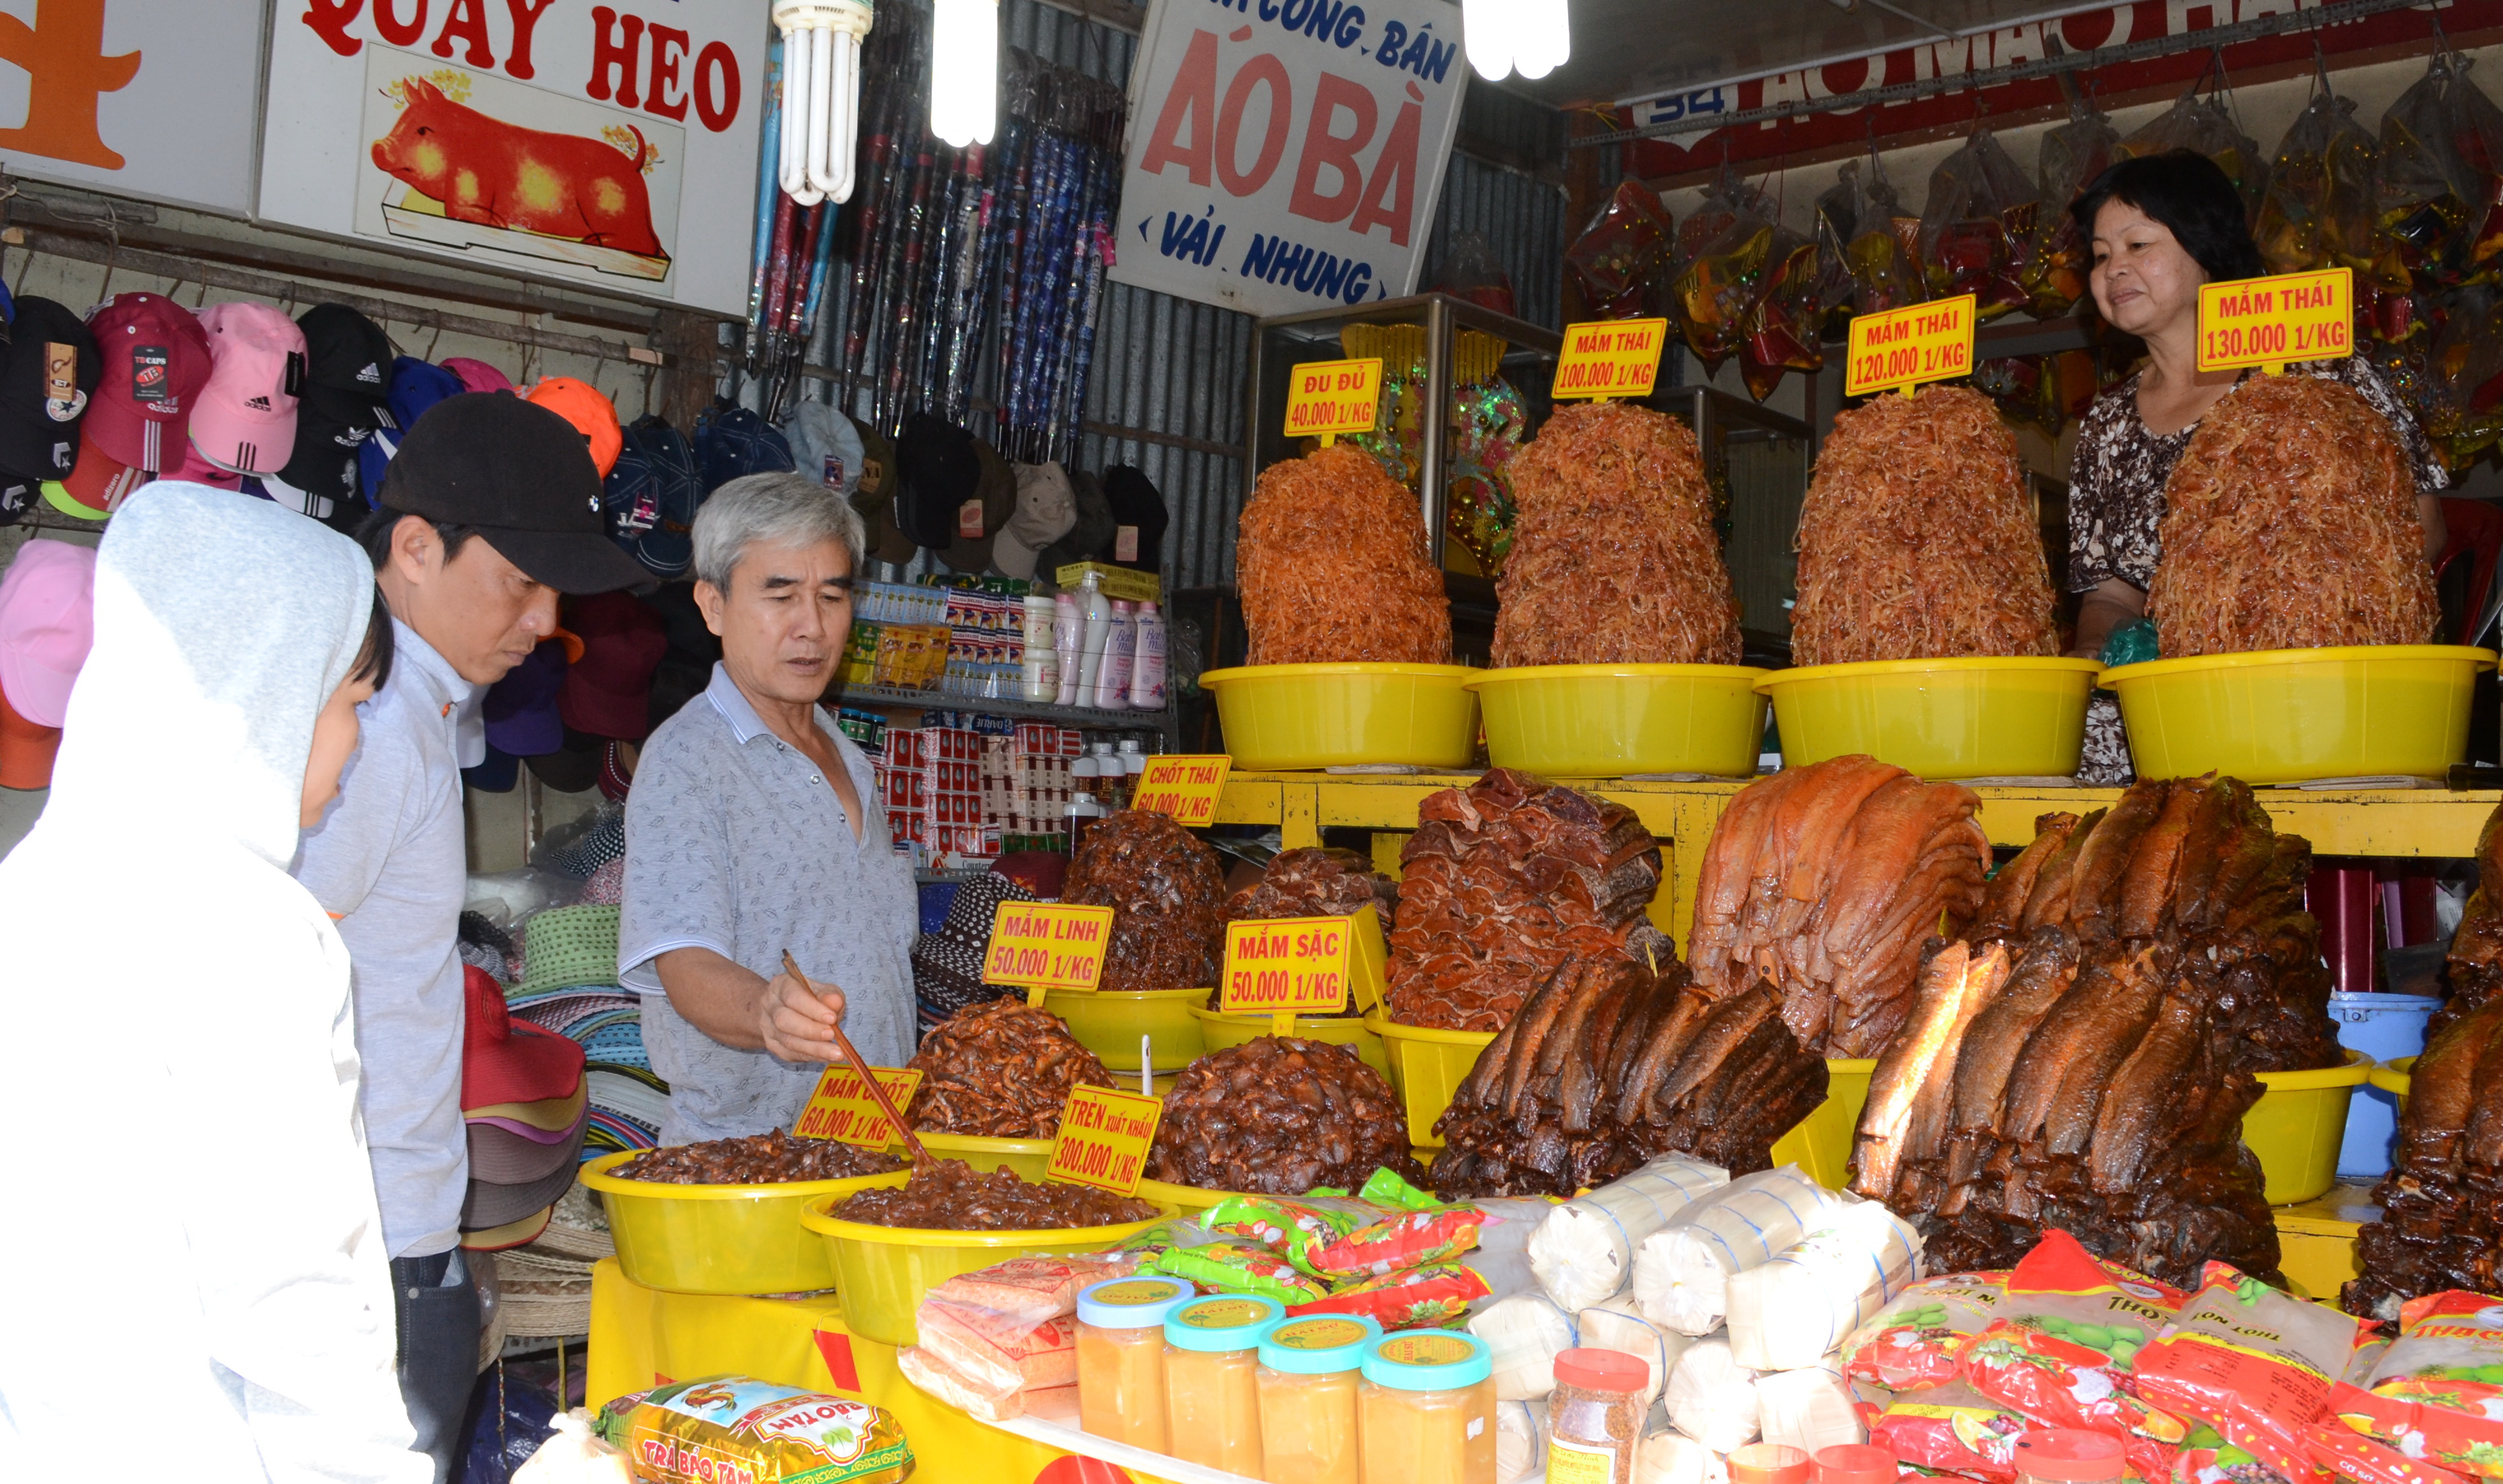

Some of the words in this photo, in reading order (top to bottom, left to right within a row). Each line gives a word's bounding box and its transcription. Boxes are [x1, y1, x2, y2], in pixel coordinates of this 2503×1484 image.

[586, 6, 741, 132] HEO
[1288, 81, 1425, 248] BÀ
[1160, 204, 1226, 266] VẢI
[1240, 234, 1372, 304] NHUNG
[2220, 285, 2272, 318] MẮM
[2280, 280, 2332, 311] THÁI
[1576, 327, 1612, 353] MẮM
[1617, 327, 1652, 351] THÁI
[1866, 314, 1909, 346] MẮM
[1916, 307, 1958, 336] THÁI
[2207, 323, 2287, 360] 130.000
[2295, 321, 2344, 350] 1/KG
[1304, 375, 1331, 393] ĐU
[1337, 365, 1365, 391] ĐỦ
[1560, 361, 1614, 388] 100.000
[1617, 363, 1652, 386] 1/KG
[1855, 346, 1919, 385] 120.000
[1924, 342, 1964, 372] 1/KG
[244, 402, 271, 412] adidas
[1292, 401, 1336, 427] 40.000
[1338, 402, 1371, 424] 1/KG
[103, 473, 120, 501] adizero
[975, 718, 1003, 729] DARLIE
[1079, 779, 1090, 790] BIG
[1102, 778, 1113, 789] BIG
[1127, 775, 1138, 787] BIG
[1150, 760, 1185, 784] CHỐT
[1188, 762, 1220, 784] THÁI
[1178, 797, 1211, 817] 1/KG
[1004, 908, 1050, 938] MẮM
[1054, 920, 1099, 942] LINH
[1238, 926, 1289, 960] MẮM
[1295, 928, 1339, 962] SẶC
[992, 946, 1048, 977] 50.000
[1052, 955, 1094, 981] 1/KG
[1230, 970, 1289, 1002] 50.000
[1295, 972, 1338, 1000] 1/KG
[801, 1106, 854, 1137] 60.000
[850, 1116, 891, 1141] 1/KG
[1069, 1095, 1108, 1130] TRÈN
[1104, 1110, 1127, 1134] XUẤT
[1126, 1112, 1153, 1139] KHẨU
[1055, 1136, 1112, 1178] 300.000
[1110, 1153, 1137, 1184] 1/KG
[768, 1410, 819, 1431] TÂM
[815, 1401, 864, 1421] BẢO
[643, 1439, 677, 1473] TRÀ
[678, 1446, 714, 1481] BẢO
[716, 1459, 753, 1484] TÂM
